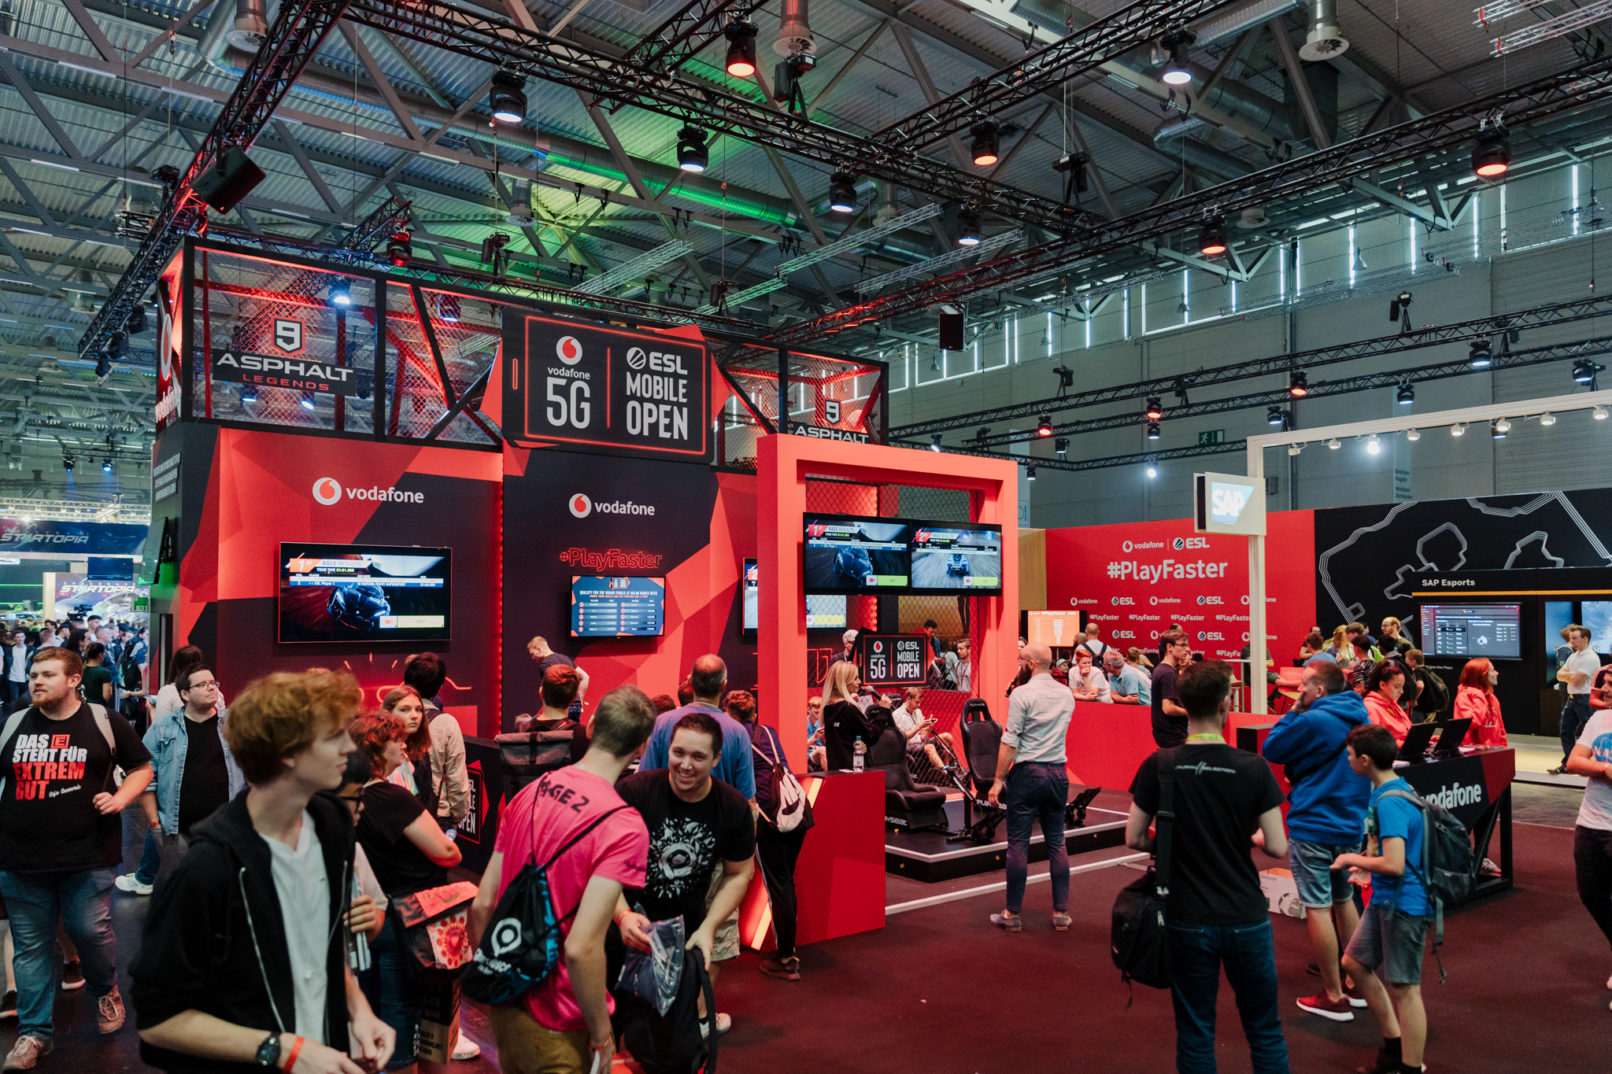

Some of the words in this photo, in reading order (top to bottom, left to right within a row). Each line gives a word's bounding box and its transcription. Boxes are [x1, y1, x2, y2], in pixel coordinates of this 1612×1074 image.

[216, 352, 353, 382] ASPHALT
[649, 352, 688, 375] ESL
[547, 366, 591, 380] vodafone
[242, 373, 329, 392] LEGENDS
[626, 371, 688, 403] MOBILE
[546, 376, 591, 429] 5G
[626, 400, 688, 440] OPEN
[795, 425, 869, 444] ASPHALT
[346, 486, 425, 503] vodafone
[1212, 488, 1245, 517] SAP
[594, 500, 655, 516] vodafone
[0, 532, 89, 544] STARTOPIA
[1134, 541, 1164, 550] vodafone
[1185, 537, 1210, 549] ESL
[559, 547, 663, 573] #PlayFaster
[1106, 559, 1228, 584] #PlayFaster
[1422, 579, 1439, 587] SAP
[1441, 579, 1475, 587] Esports
[1119, 597, 1136, 605] ESL
[1206, 596, 1224, 605] ESL
[1128, 614, 1160, 622] #PlayFaster
[1170, 614, 1205, 622] #PlayFaster
[1215, 614, 1251, 622] #PlayFaste
[1120, 630, 1136, 639] ESL
[1207, 632, 1225, 641] ESL
[905, 641, 919, 650] ESL
[897, 651, 920, 662] MOBILE
[870, 658, 886, 679] 5G
[897, 663, 920, 678] OPEN
[15, 734, 50, 749] DAS
[12, 748, 58, 763] STEHT
[60, 745, 87, 762] FÜR
[12, 761, 85, 780] EXTREM
[16, 780, 50, 800] GUT
[571, 795, 590, 813] 2
